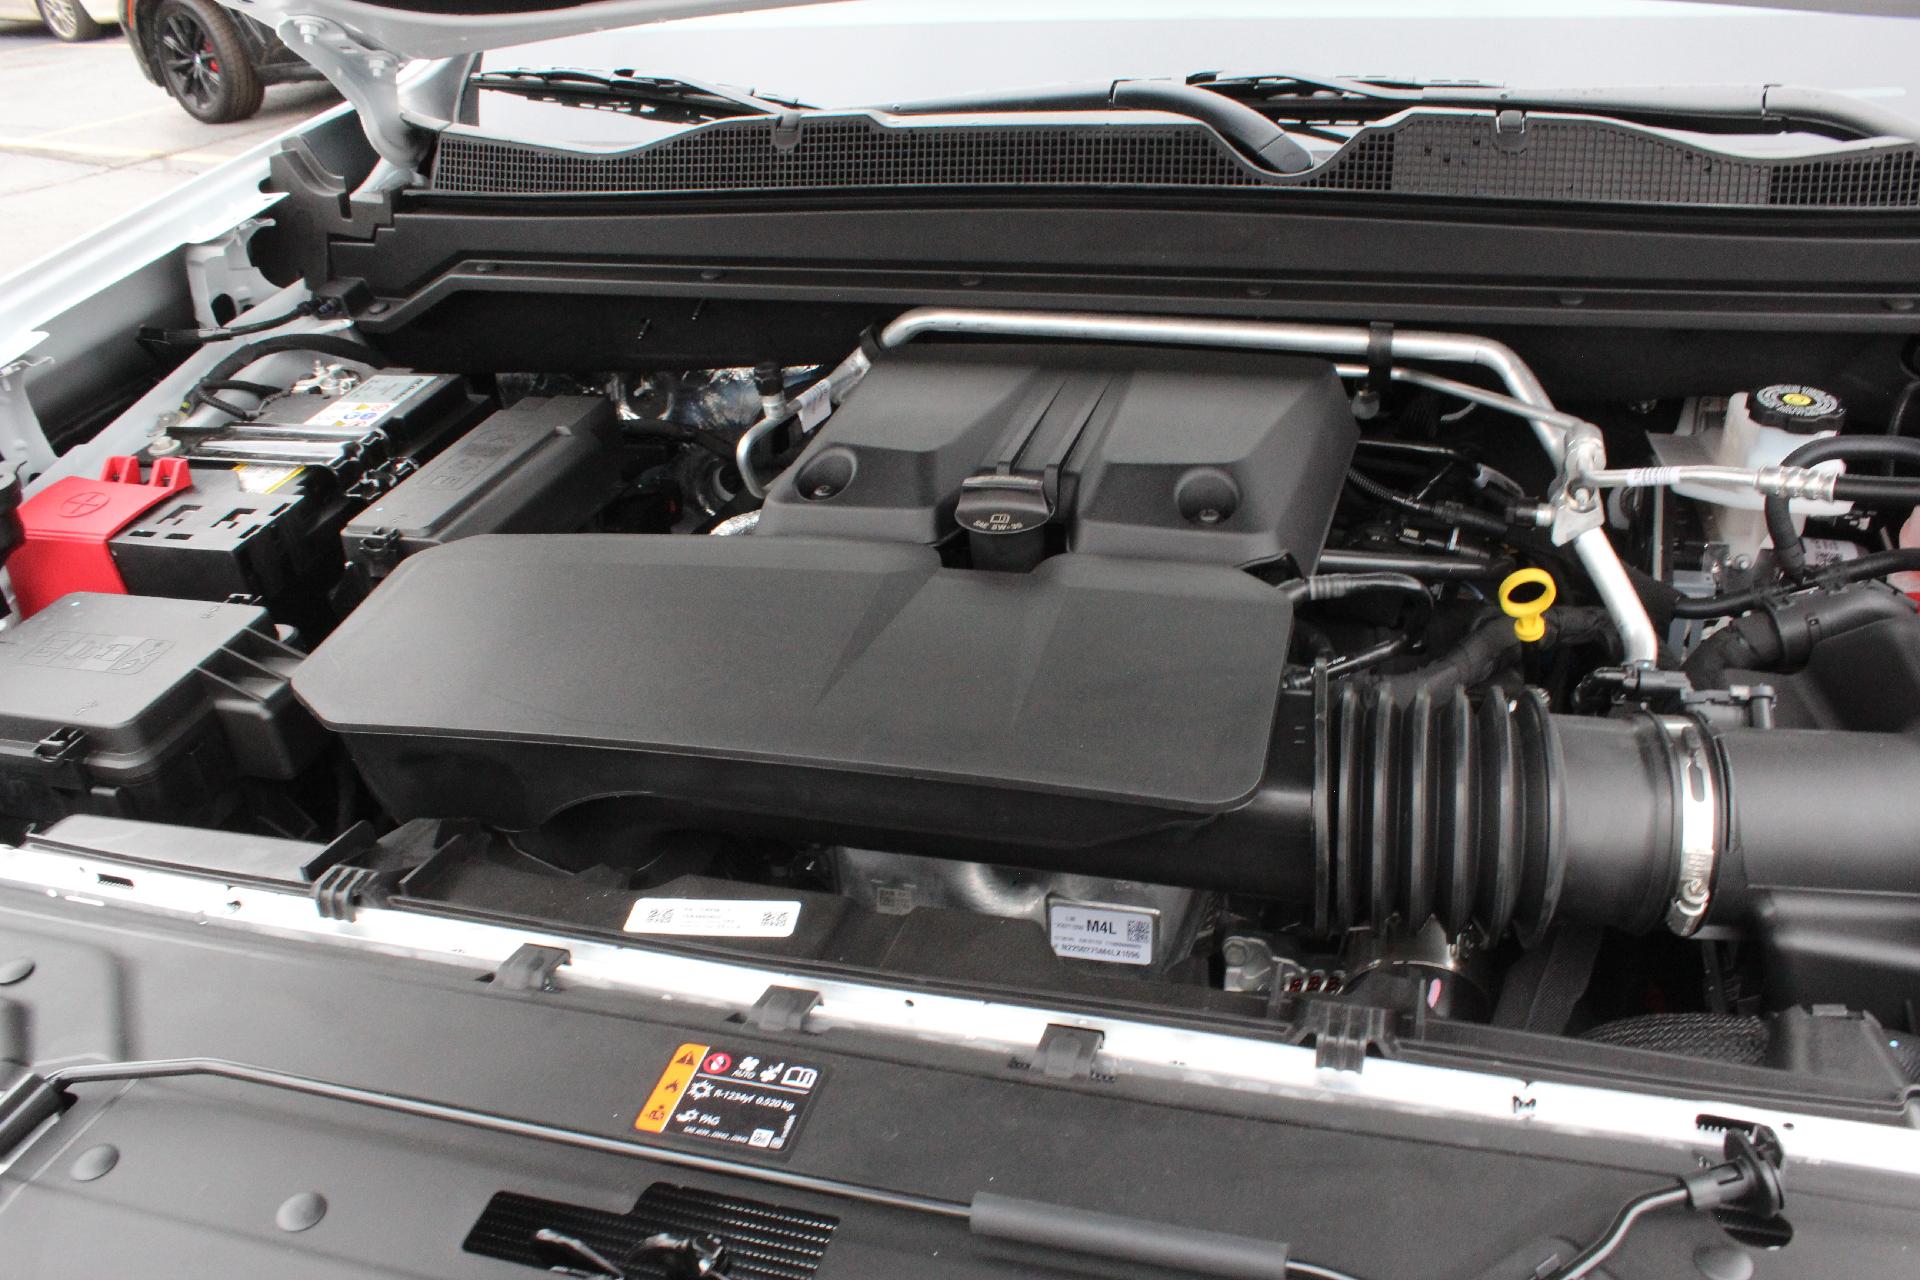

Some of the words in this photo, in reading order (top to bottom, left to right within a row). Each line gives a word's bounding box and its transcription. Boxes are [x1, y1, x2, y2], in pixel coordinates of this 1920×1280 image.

[1087, 919, 1117, 935] M4L
[732, 1069, 756, 1079] AUTO
[781, 1100, 795, 1112] kg
[699, 1114, 721, 1126] PAG
